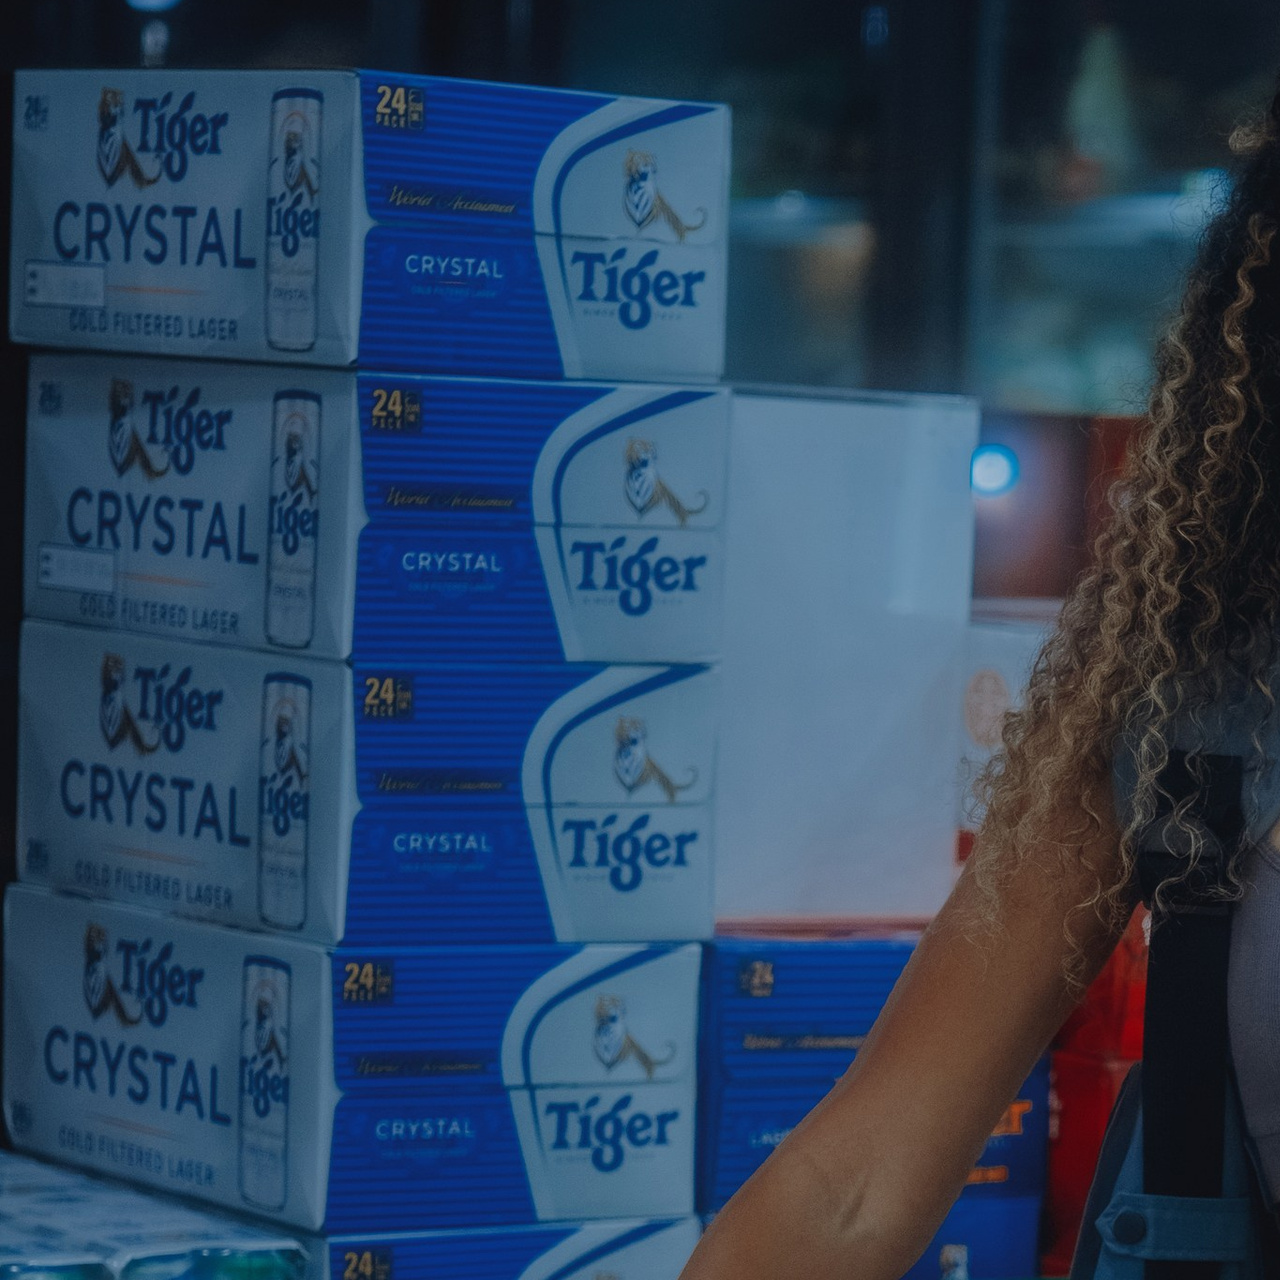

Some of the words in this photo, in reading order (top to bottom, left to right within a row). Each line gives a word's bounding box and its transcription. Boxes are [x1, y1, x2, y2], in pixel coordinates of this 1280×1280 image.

[376, 85, 406, 116] 24
[134, 91, 229, 182] Tiger
[54, 202, 257, 269] CRYSTAL
[404, 254, 504, 279] CRYSTAL
[572, 247, 705, 330] Tiger
[112, 311, 183, 339] FILTERED
[187, 317, 239, 341] LAGER
[372, 388, 402, 418] 24
[142, 385, 233, 476] Tiger
[67, 486, 259, 565] CRYSTAL
[402, 551, 503, 574] CRYSTAL
[571, 536, 706, 616] Tiger
[121, 598, 187, 629] FILTERED
[191, 605, 239, 635] LAGER
[134, 663, 223, 753] Tiger
[364, 677, 395, 706] 24
[60, 760, 251, 848] CRYSTAL
[393, 832, 492, 854] CRYSTAL
[563, 813, 698, 892] Tiger
[114, 866, 181, 901] FILTERED
[186, 879, 233, 909] LAGER
[117, 937, 204, 1028] Tiger
[344, 962, 374, 991] 24
[44, 1026, 232, 1127] CRYSTAL
[375, 1117, 476, 1141] CRYSTAL
[546, 1095, 679, 1173] Tiger
[168, 1153, 215, 1187] LAGER
[343, 1251, 373, 1280] 24
